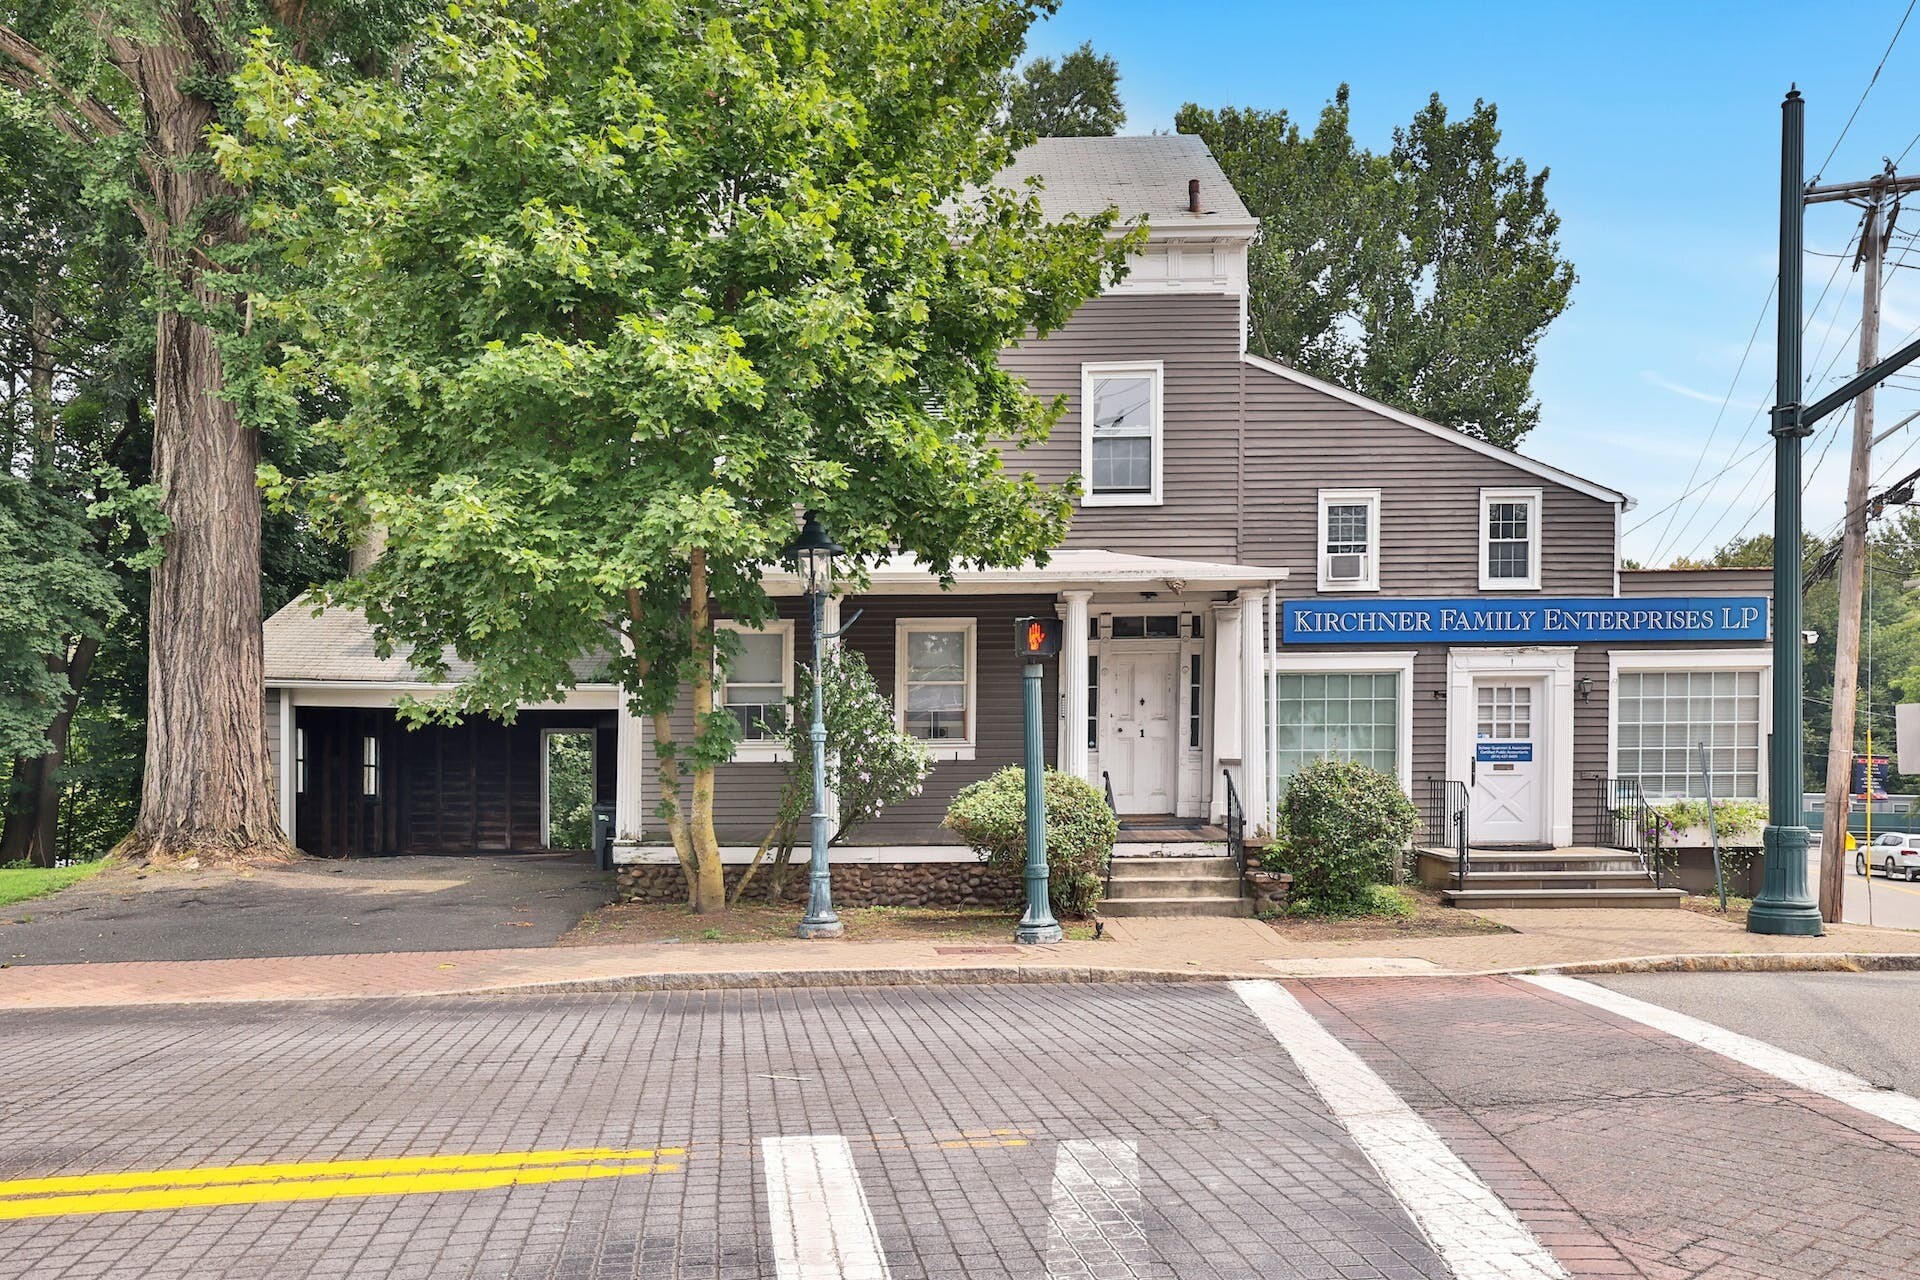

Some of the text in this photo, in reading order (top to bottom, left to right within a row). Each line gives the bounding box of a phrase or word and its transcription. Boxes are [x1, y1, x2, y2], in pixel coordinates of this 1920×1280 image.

[1293, 607, 1760, 632] KIRCHNER FAMILY ENTERPRISES LP
[1140, 728, 1144, 738] 1
